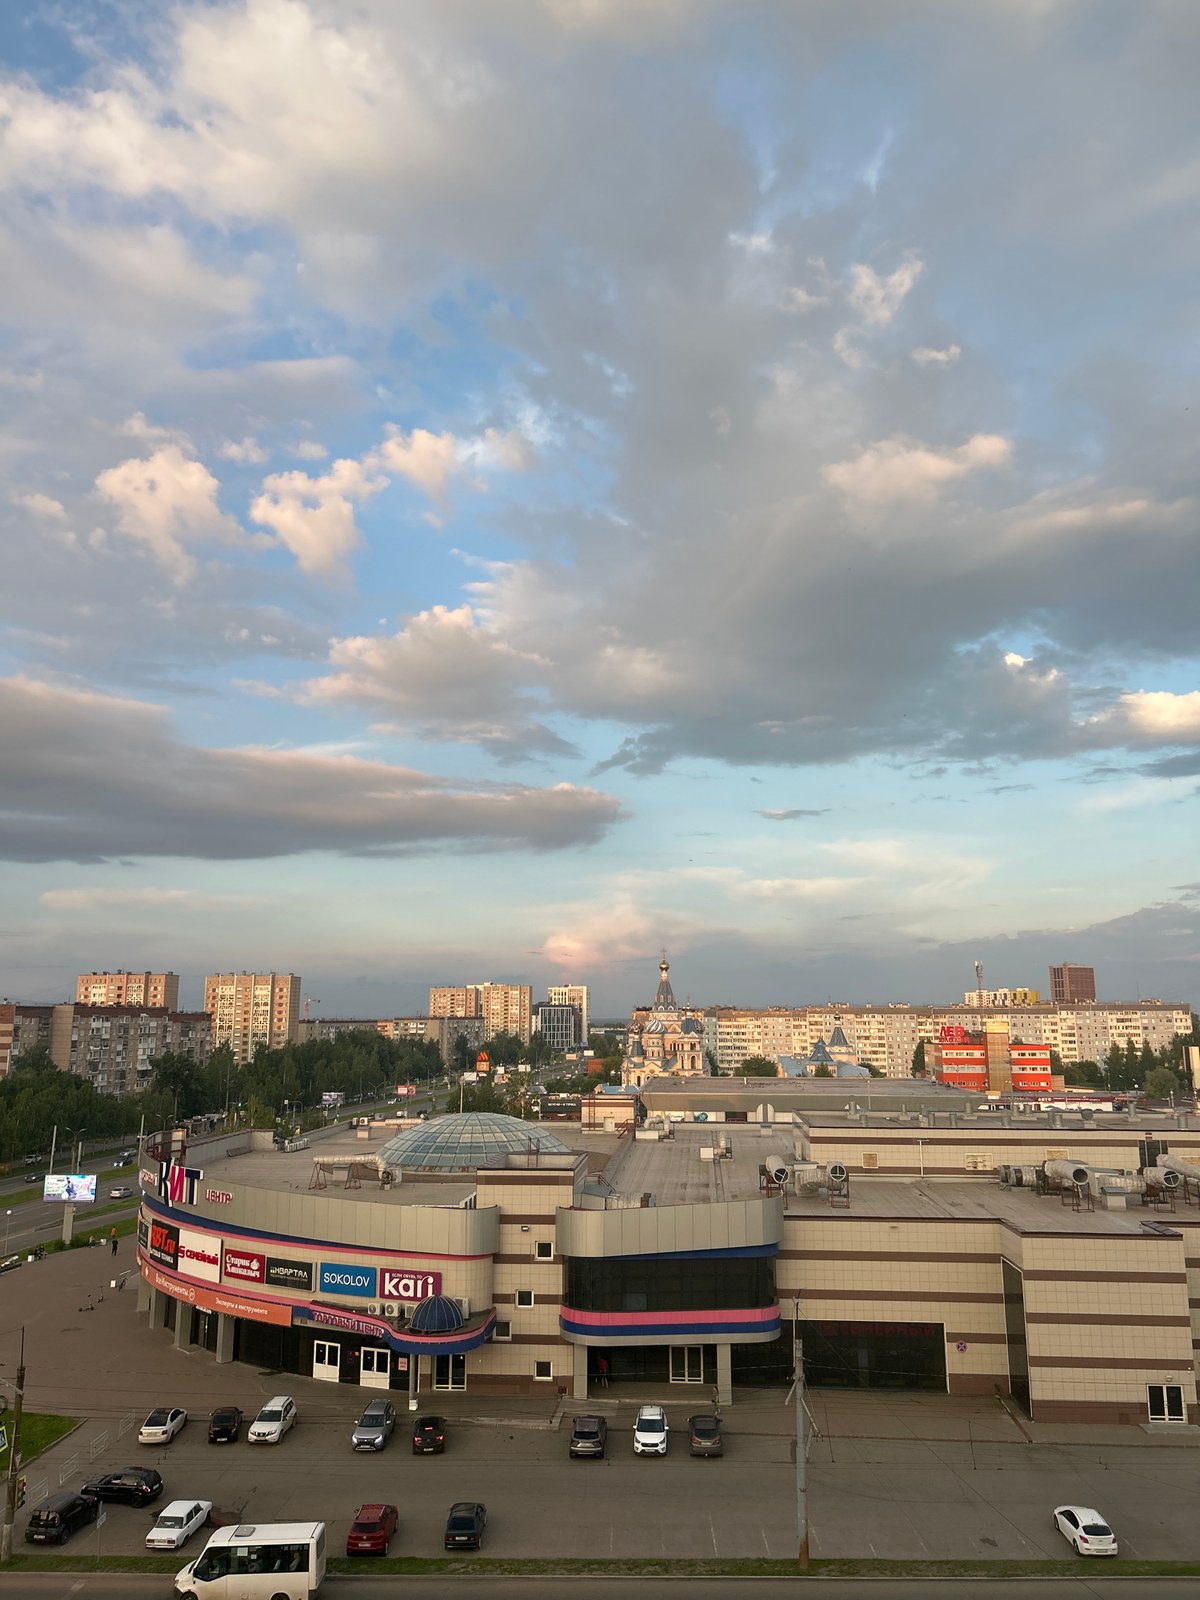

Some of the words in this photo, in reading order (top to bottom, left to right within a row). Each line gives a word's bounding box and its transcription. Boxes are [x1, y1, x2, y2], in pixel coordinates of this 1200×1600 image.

[940, 1026, 965, 1037] ЛЕВ
[158, 1157, 204, 1208] КИТ
[205, 1188, 233, 1204] ЦЕНТР
[226, 1254, 251, 1267] Старик
[226, 1263, 260, 1278] Хинкалыч
[274, 1267, 309, 1279] КВАРТАЛ
[323, 1272, 370, 1287] SOKOLOV
[384, 1272, 434, 1298] kari
[215, 1297, 234, 1309] Эксперты
[312, 1310, 358, 1331] ТОРГОВЫЙ
[359, 1321, 385, 1338] ЦЕНТР
